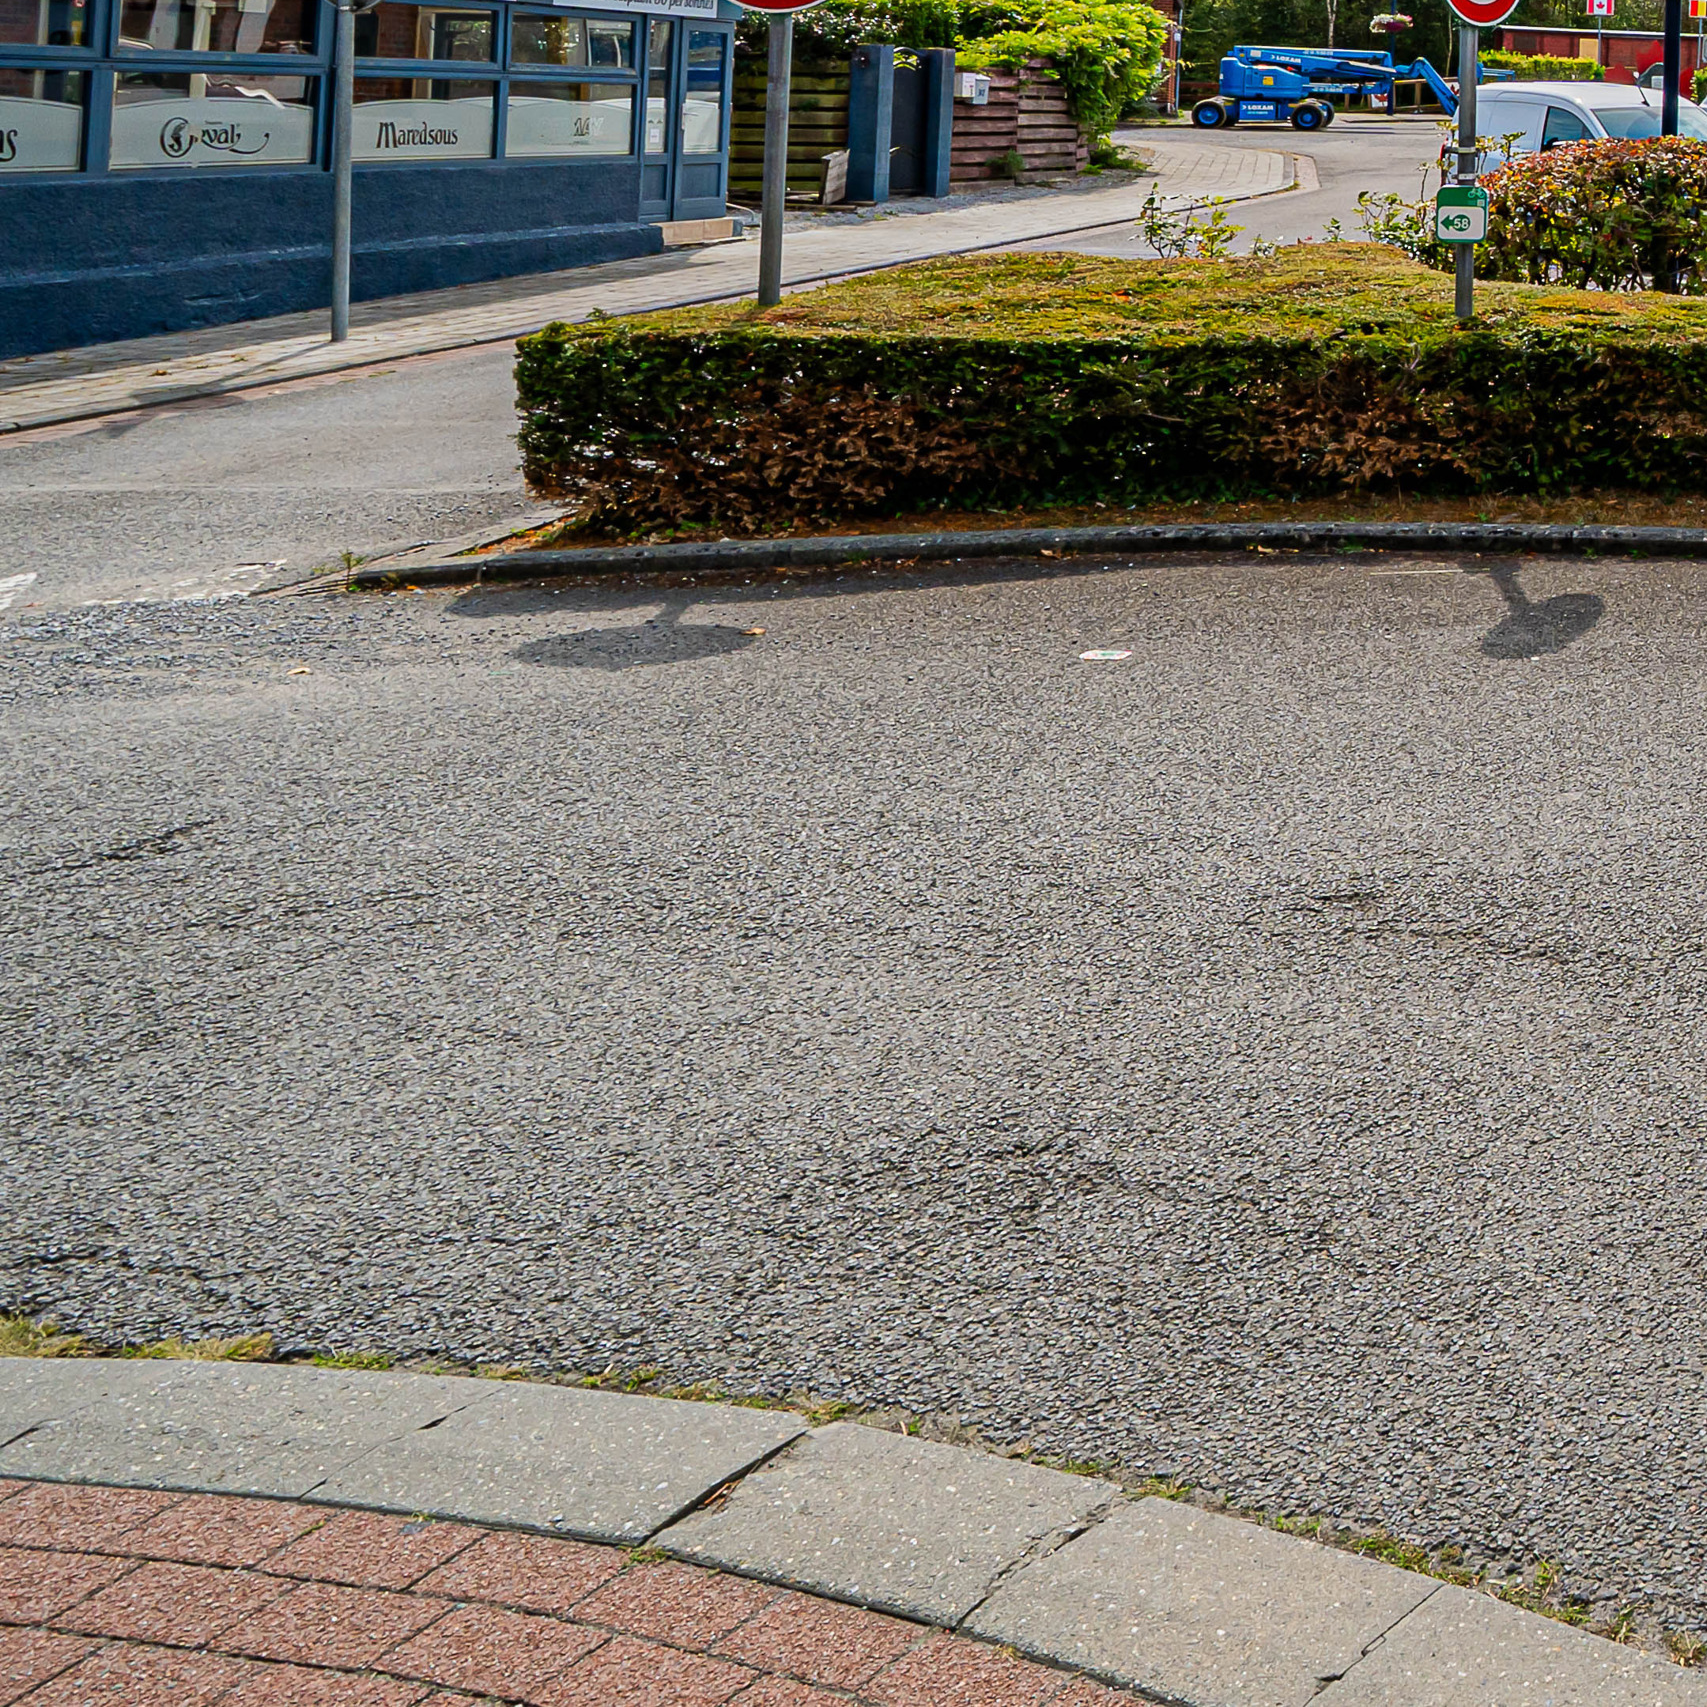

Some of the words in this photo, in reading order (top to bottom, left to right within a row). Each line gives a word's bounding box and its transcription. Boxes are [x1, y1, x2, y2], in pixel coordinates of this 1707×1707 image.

[1276, 55, 1302, 63] LOXAM
[375, 120, 458, 149] Maredsous
[1454, 218, 1469, 229] 58
